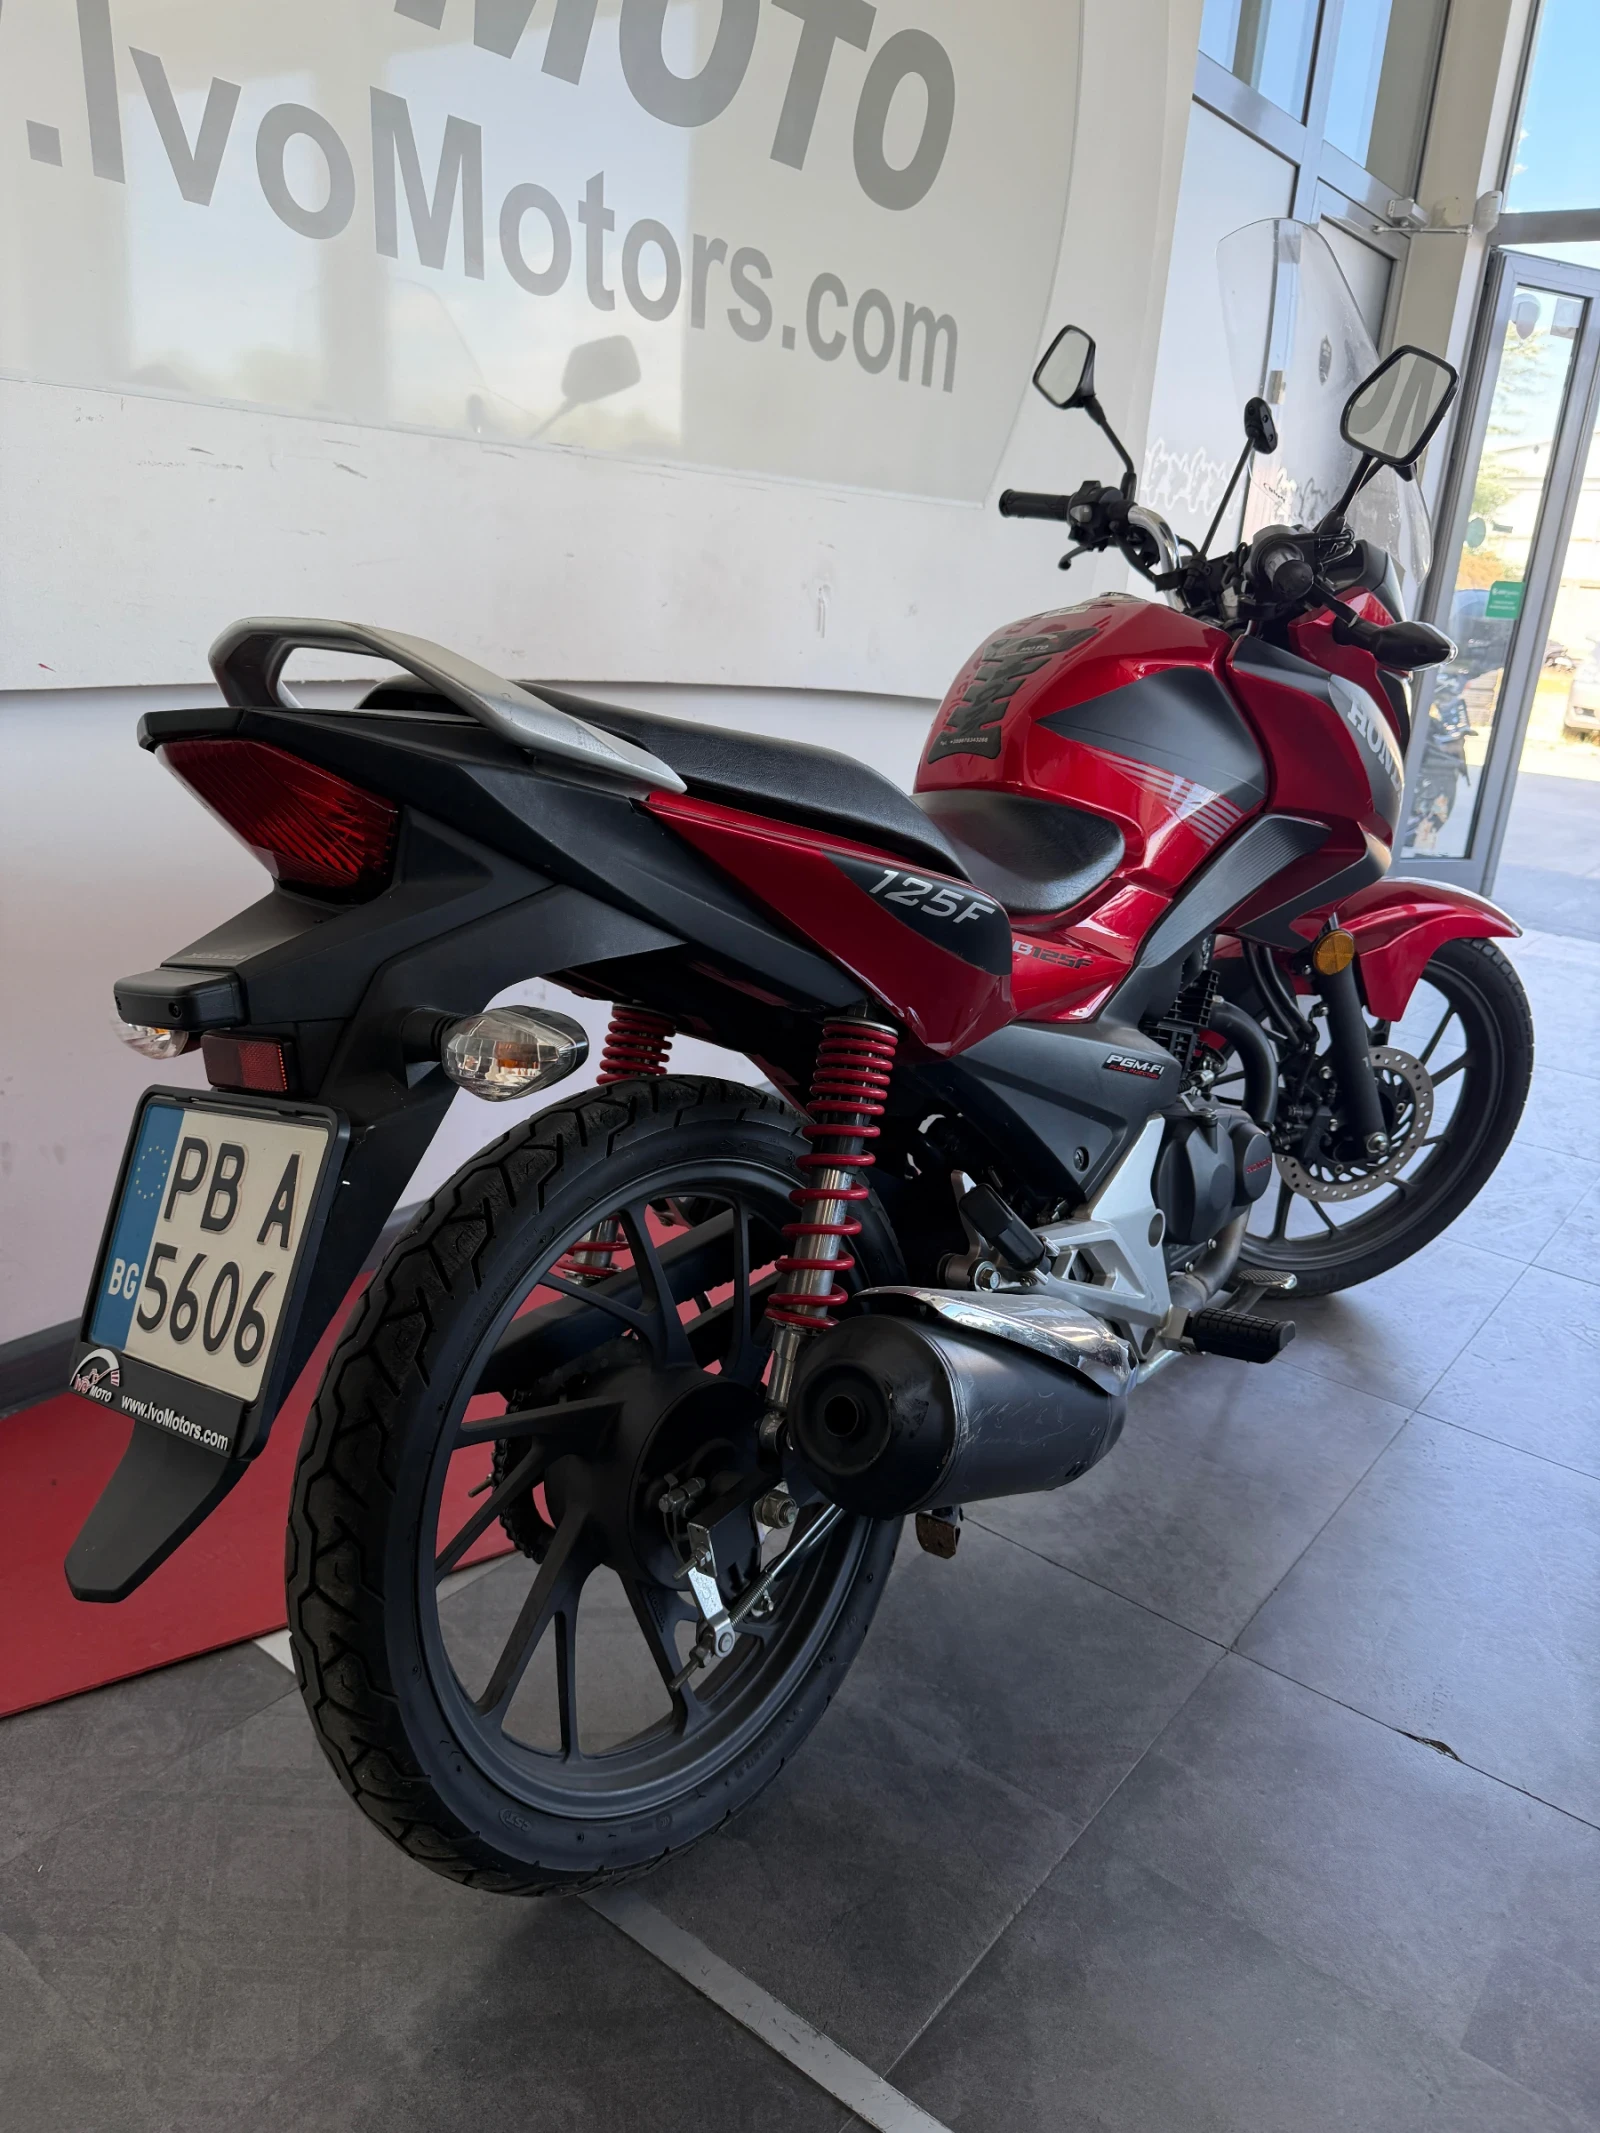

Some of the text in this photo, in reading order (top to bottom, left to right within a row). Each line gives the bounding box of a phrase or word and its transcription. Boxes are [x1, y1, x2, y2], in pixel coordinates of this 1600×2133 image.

[869, 869, 995, 923] 125F
[1012, 940, 1094, 970] B125F
[163, 1136, 300, 1249] PB A
[107, 1258, 140, 1300] BG
[136, 1241, 276, 1366] 5606
[88, 1385, 112, 1402] MOTO
[121, 1395, 229, 1451] www.IvoMotors.com
